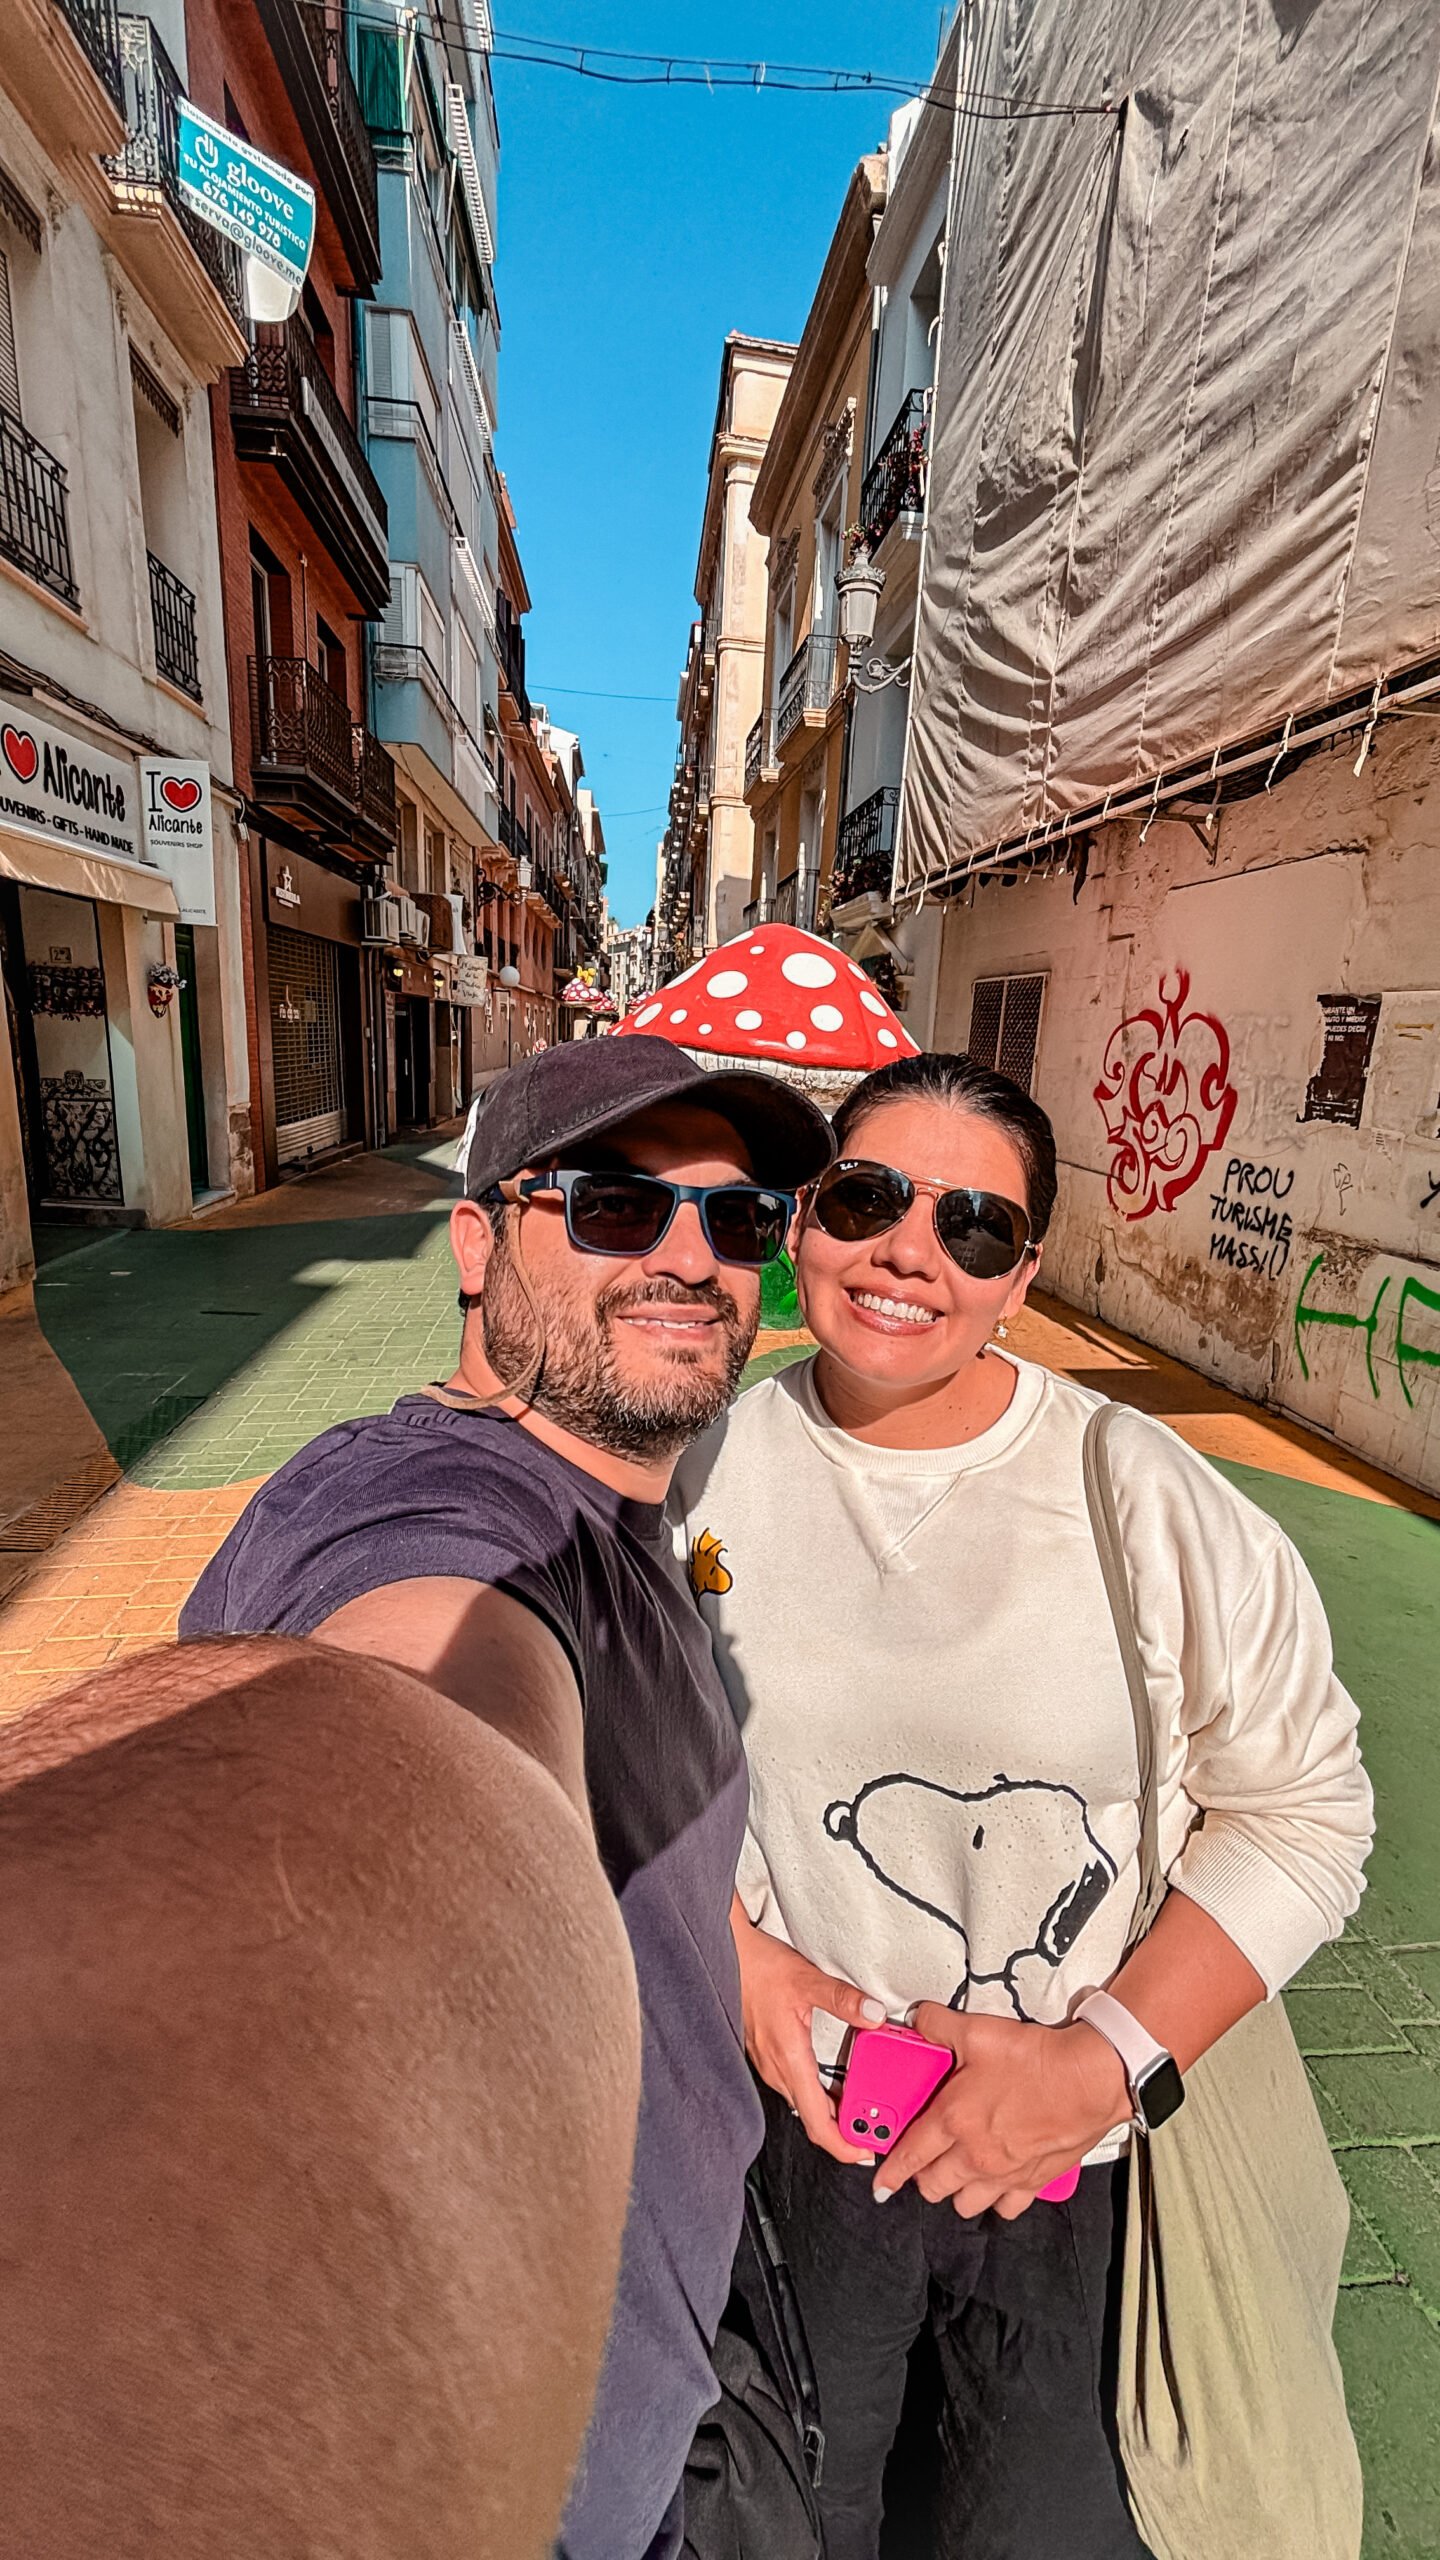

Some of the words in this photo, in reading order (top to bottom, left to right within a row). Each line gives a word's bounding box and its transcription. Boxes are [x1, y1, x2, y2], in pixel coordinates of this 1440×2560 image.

[183, 153, 198, 169] TU
[199, 165, 263, 215] ALOJAMIENTO
[226, 159, 294, 220] gloove
[202, 181, 228, 207] 676
[233, 200, 255, 226] 149
[258, 222, 281, 248] 978
[43, 741, 126, 822] Alicante
[145, 771, 163, 812] I
[0, 795, 46, 824] UVENIRS
[52, 815, 79, 834] GIFTS
[84, 826, 110, 846] HAND
[111, 834, 135, 854] MADE
[149, 814, 203, 835] Alicante
[150, 839, 185, 848] SOUVENIRS
[1347, 1025, 1367, 1033] DECIR
[1223, 1158, 1294, 1199] PROU
[1210, 1193, 1293, 1244] TURISME
